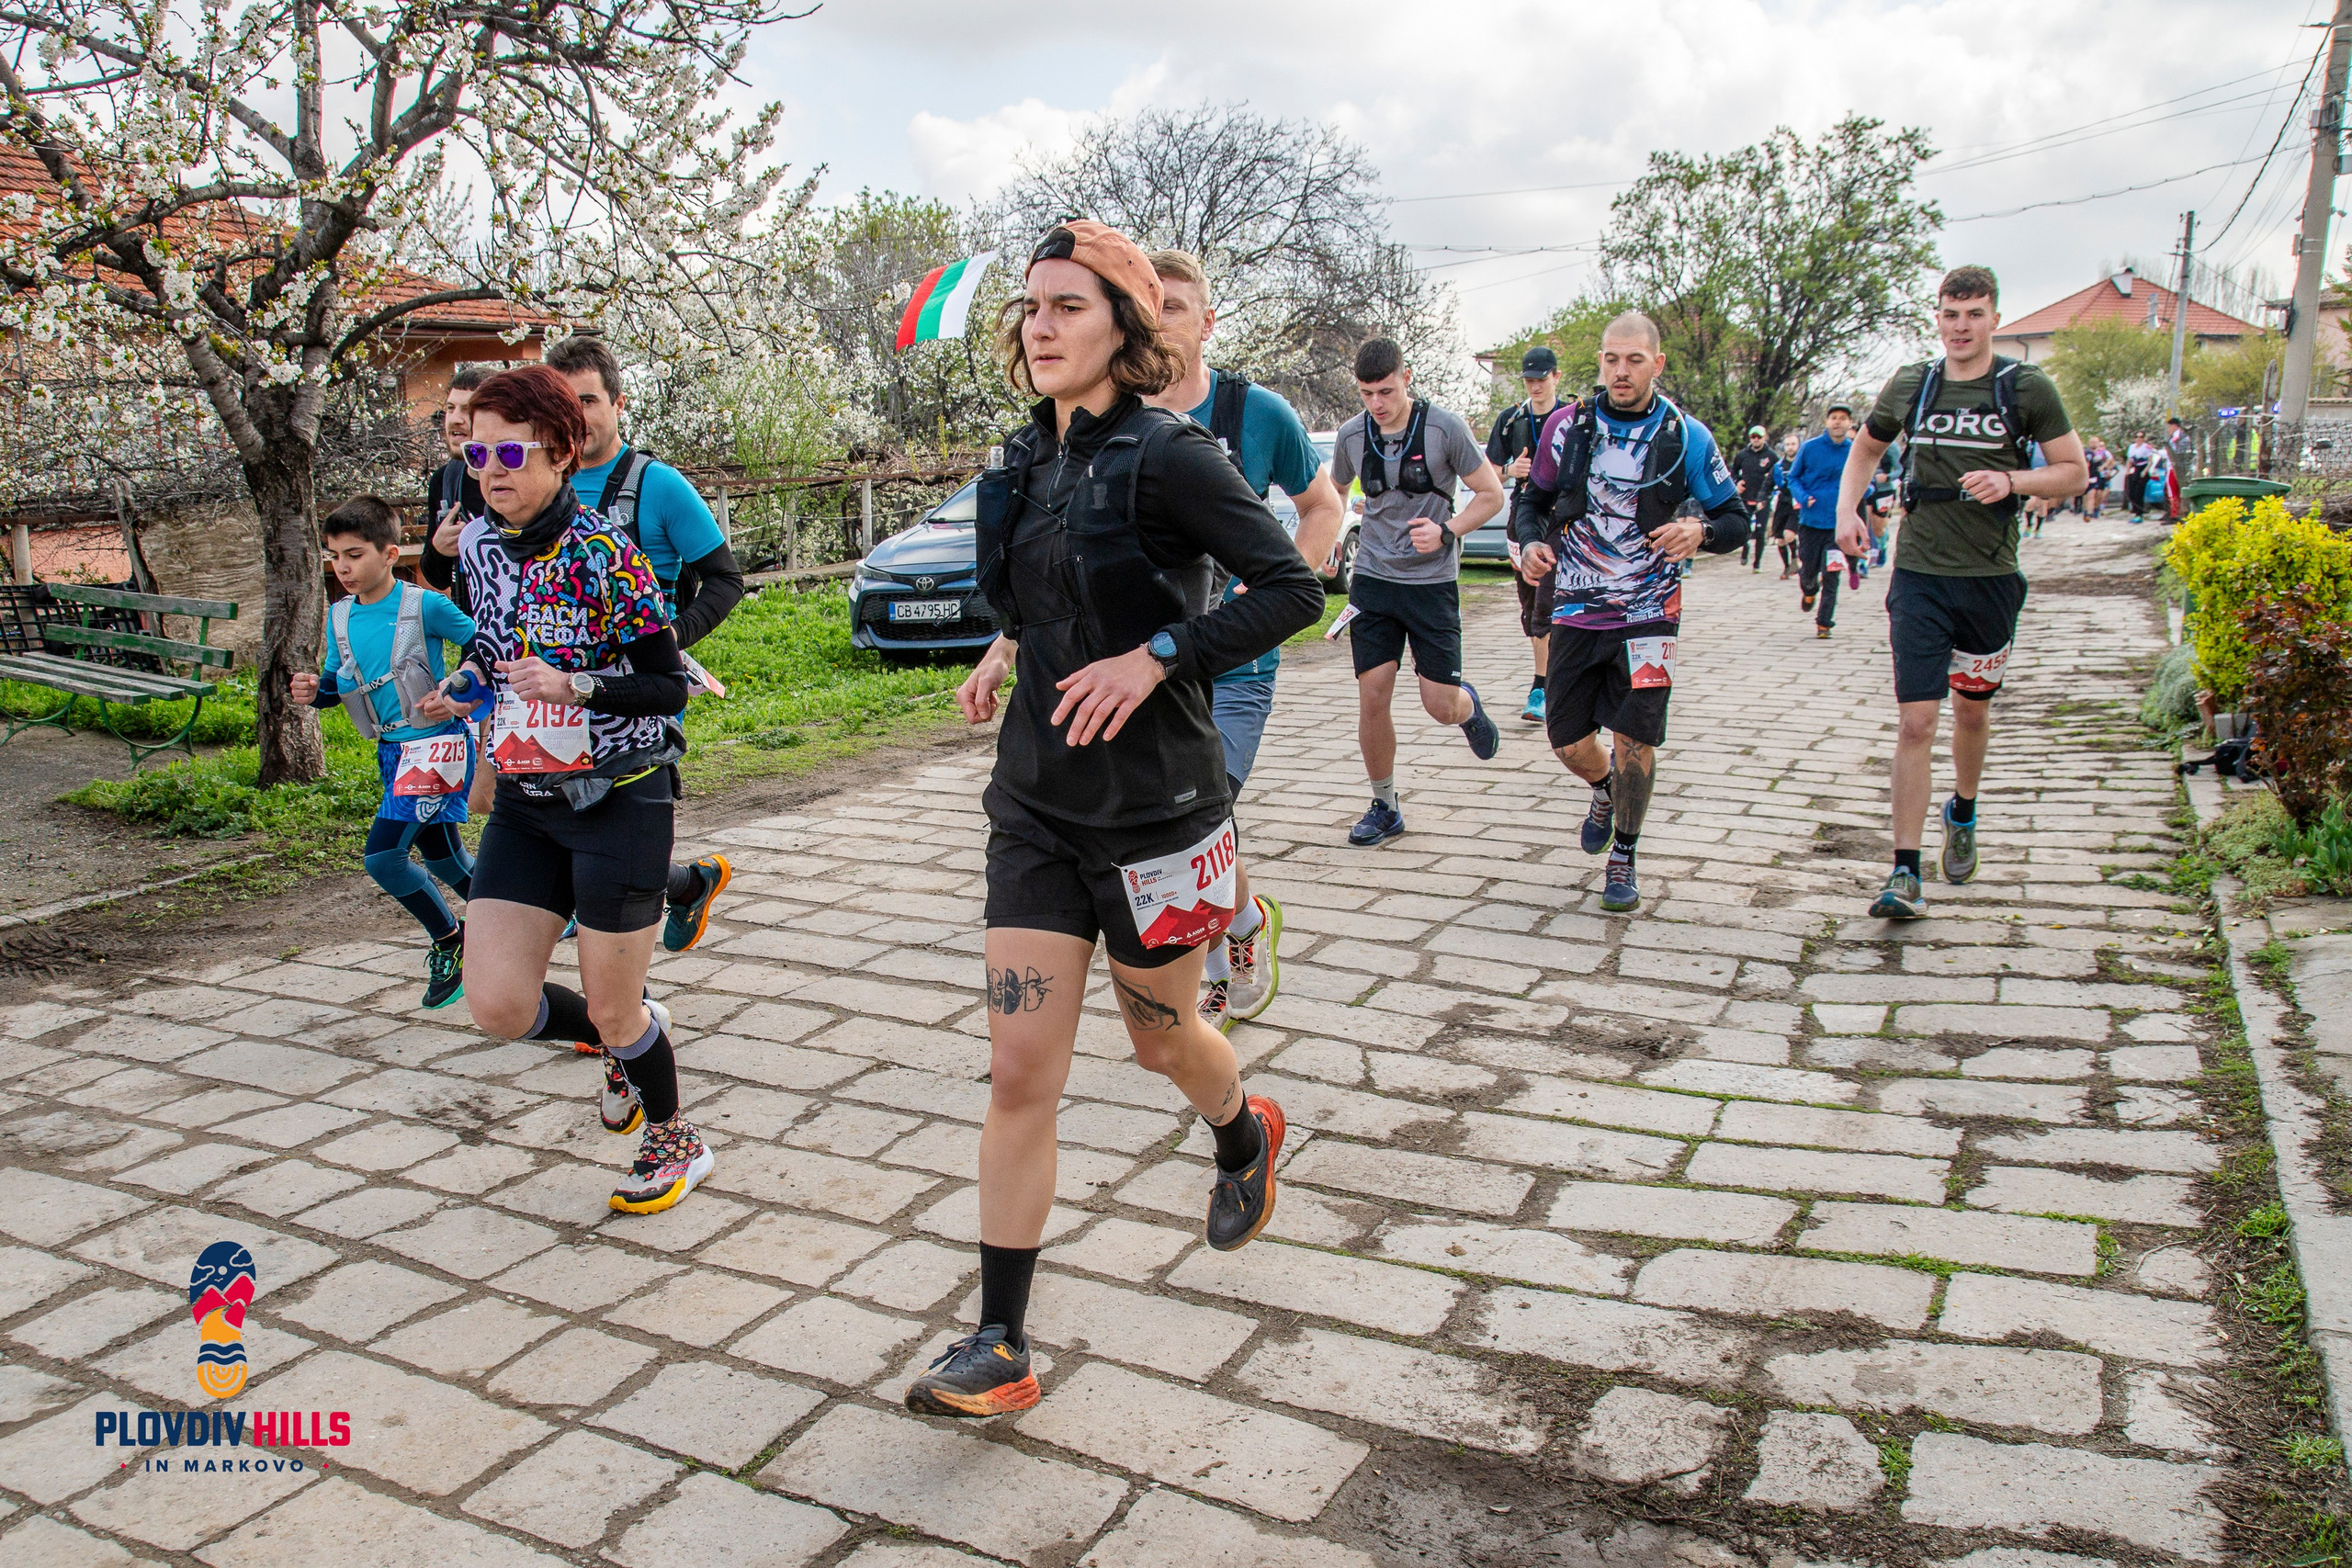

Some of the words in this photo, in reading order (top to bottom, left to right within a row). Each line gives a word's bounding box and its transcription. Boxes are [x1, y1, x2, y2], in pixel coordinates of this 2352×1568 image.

[1917, 413, 2007, 437] ORG
[527, 604, 588, 626] БАСИ
[913, 604, 942, 617] 4795
[526, 624, 592, 645] КЕФА
[526, 698, 583, 728] 2192
[428, 740, 466, 763] 2213
[1190, 829, 1235, 892] 2118
[1139, 868, 1162, 880] PLOVDIV
[1141, 877, 1158, 886] HILLS
[1135, 893, 1155, 907] 22K
